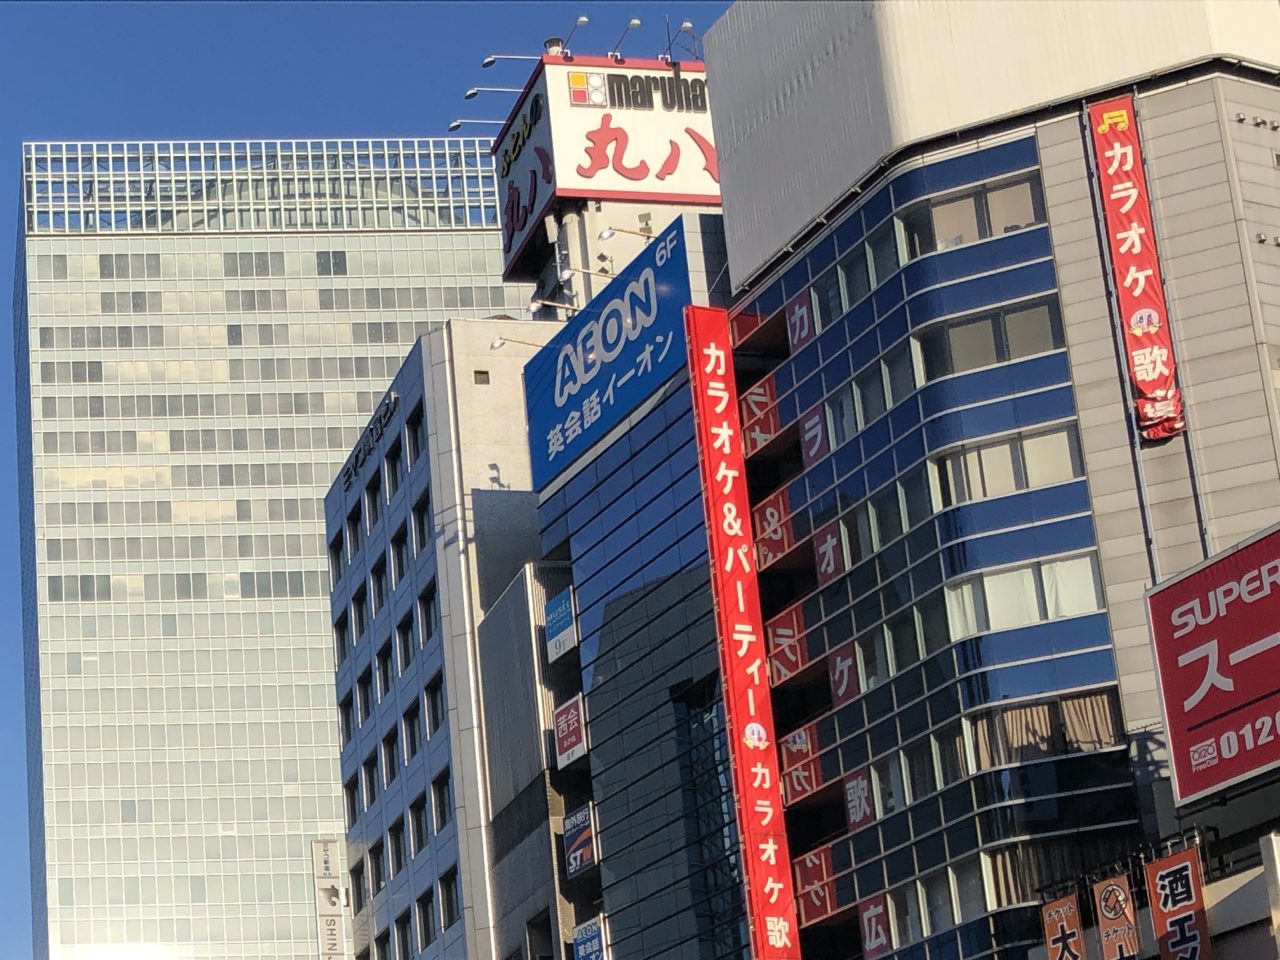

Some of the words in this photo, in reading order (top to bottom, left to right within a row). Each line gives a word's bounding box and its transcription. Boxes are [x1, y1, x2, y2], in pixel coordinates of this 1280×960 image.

[606, 63, 710, 114] maruha
[576, 113, 720, 184] 丸八
[504, 147, 553, 254] 丸八
[1104, 142, 1154, 298] カラオケ
[655, 230, 678, 267] 6F
[554, 267, 658, 408] AEON
[546, 331, 674, 462] 英会話イーオン
[703, 342, 762, 716] カラオケ&パーティー
[1171, 558, 1280, 640] SUPER
[557, 708, 579, 738] 茜会
[568, 844, 592, 870] STW
[1156, 861, 1196, 913] 酒
[578, 938, 600, 957] 英会話
[1104, 923, 1135, 942] チケット
